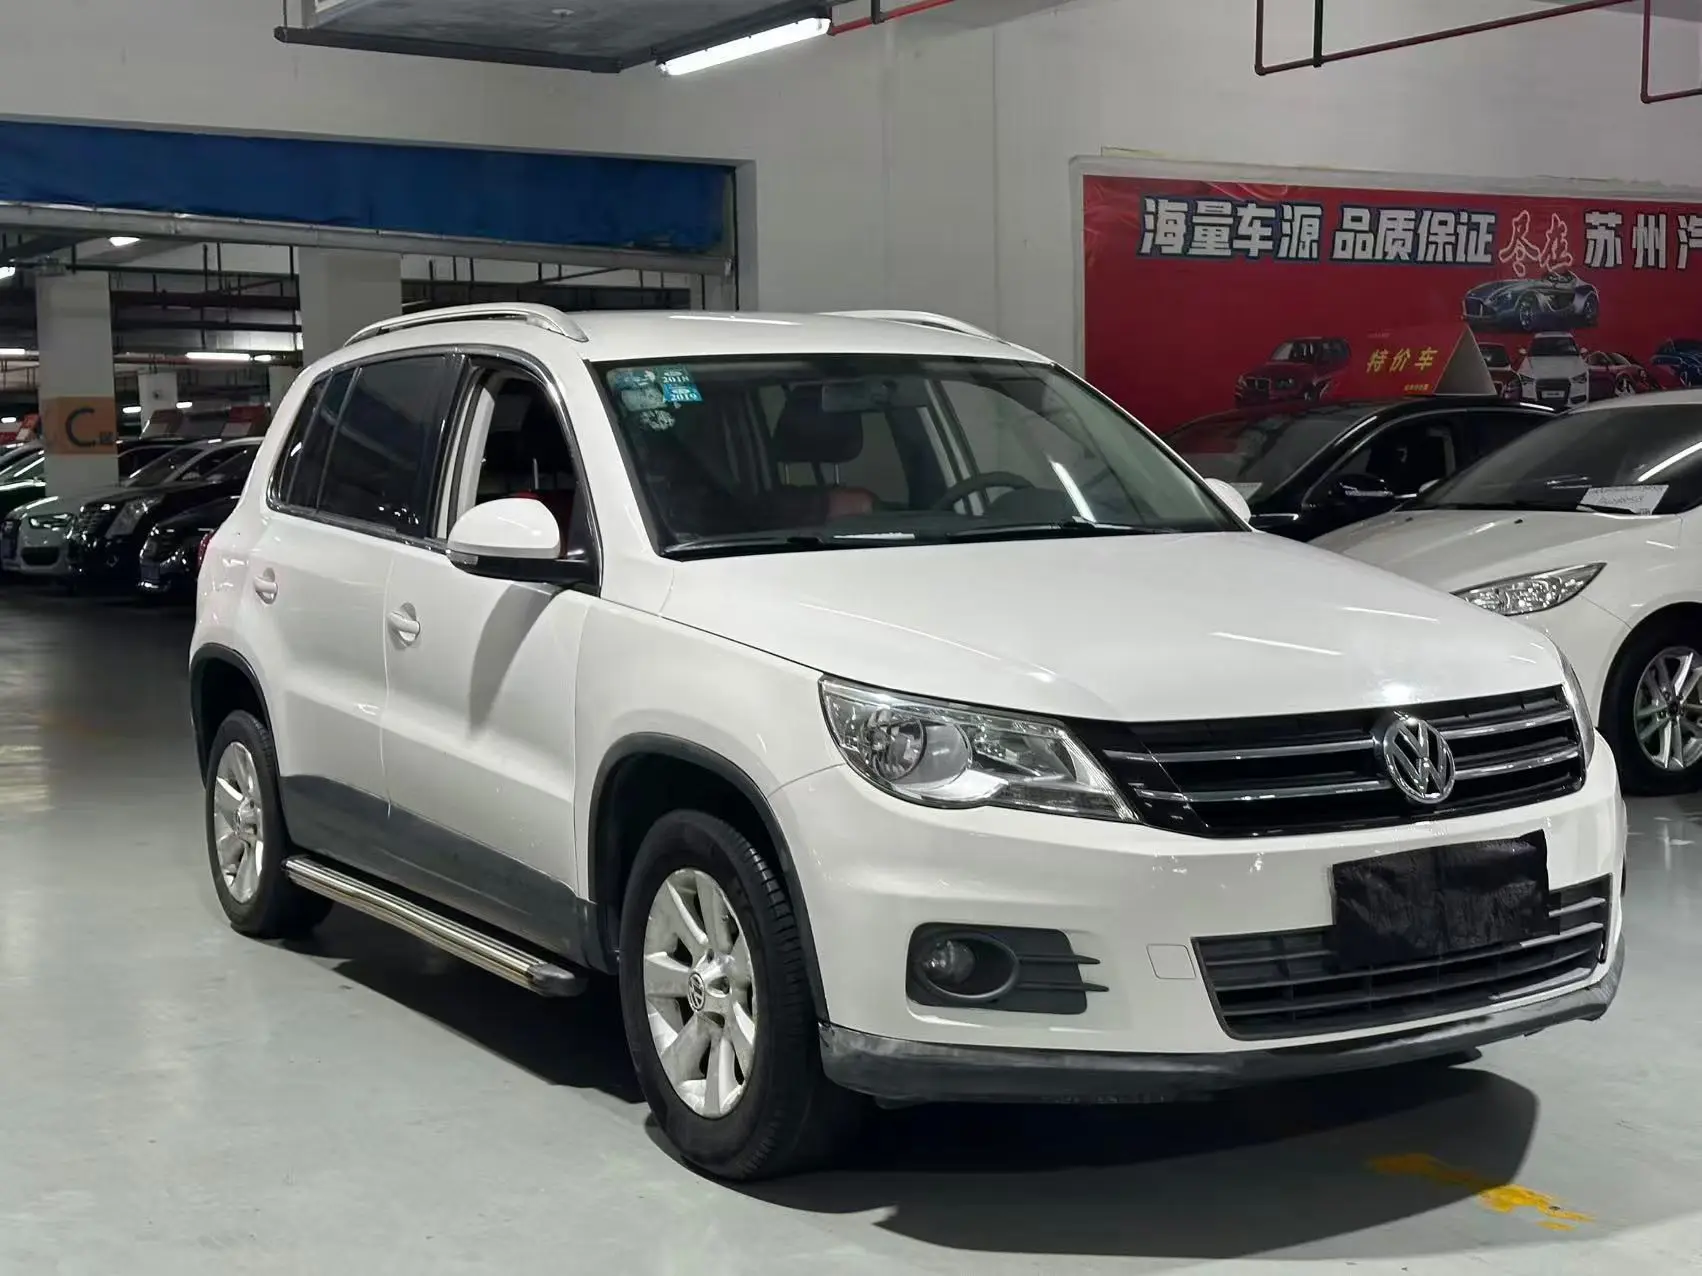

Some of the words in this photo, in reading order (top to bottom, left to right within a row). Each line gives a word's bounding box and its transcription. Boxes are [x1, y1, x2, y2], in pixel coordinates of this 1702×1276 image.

[1140, 197, 1323, 258] 海量车源
[1332, 206, 1496, 264] 品质保证
[1366, 346, 1439, 373] 特价车
[65, 407, 96, 447] C
